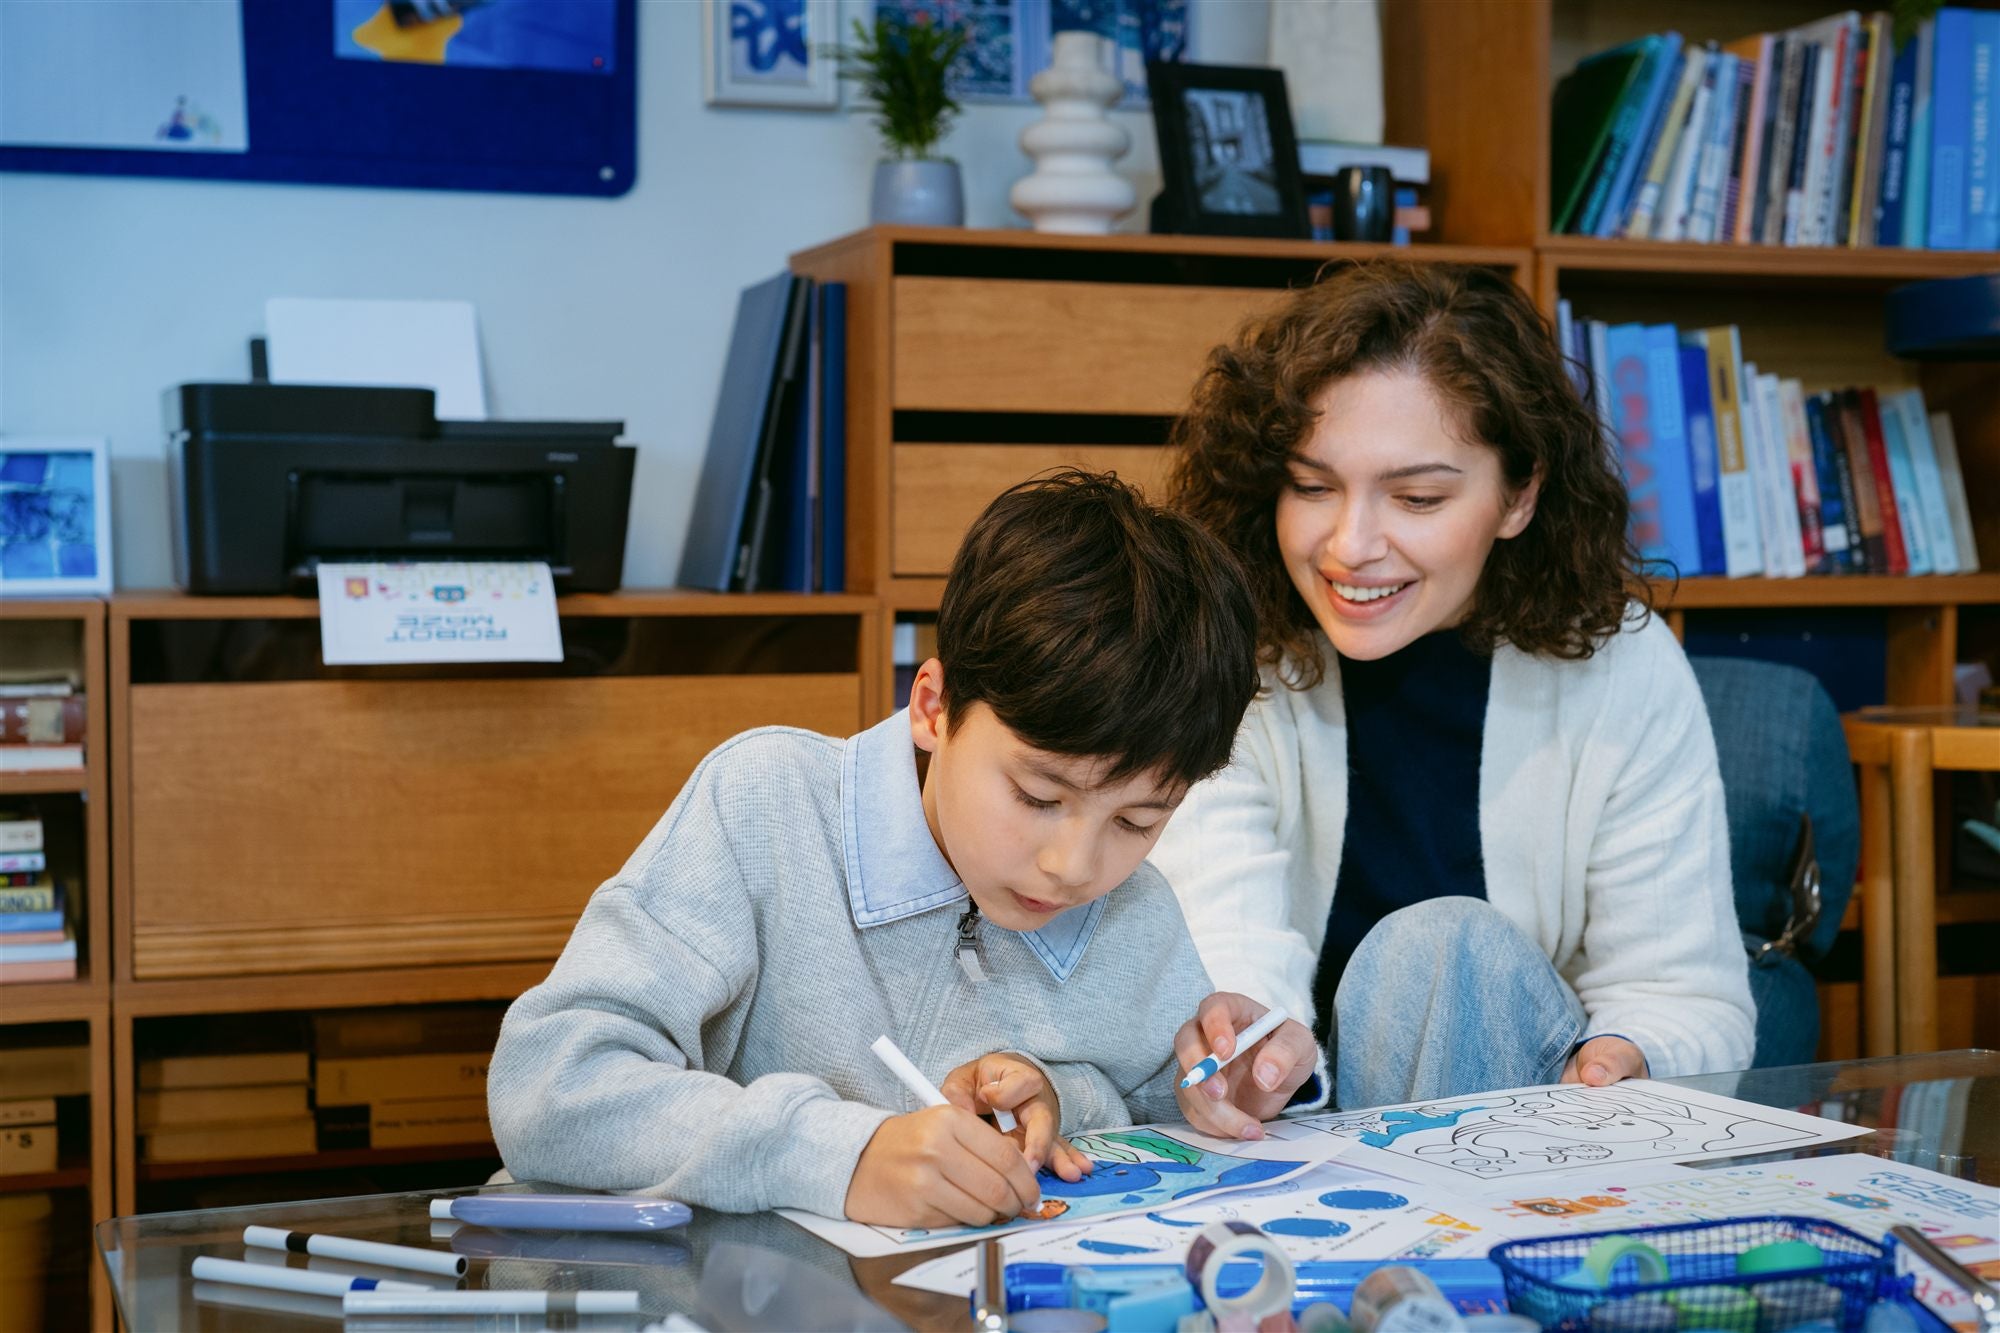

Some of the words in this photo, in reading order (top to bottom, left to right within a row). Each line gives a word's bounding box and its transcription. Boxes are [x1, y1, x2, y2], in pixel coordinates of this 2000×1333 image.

[395, 615, 494, 628] MAZE
[385, 627, 509, 642] ROBOT
[1858, 1177, 1999, 1220] MAZE
